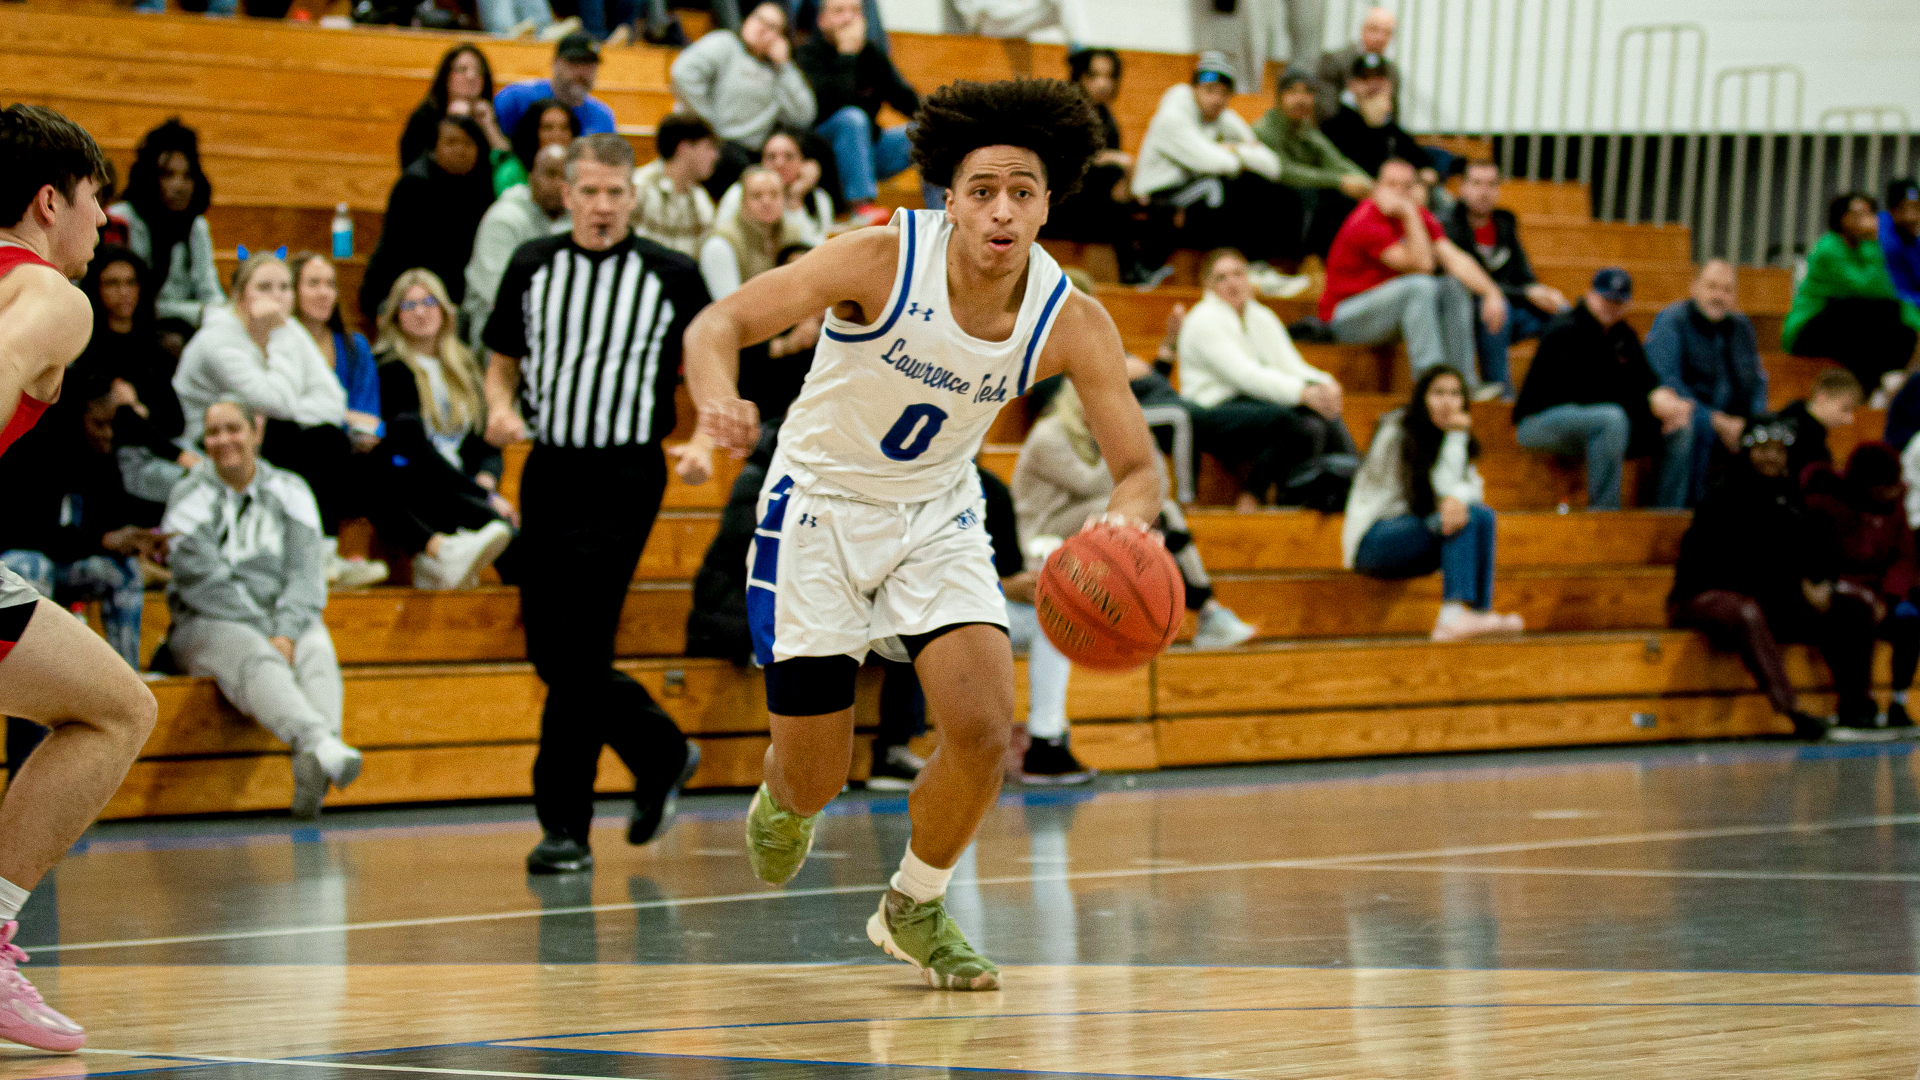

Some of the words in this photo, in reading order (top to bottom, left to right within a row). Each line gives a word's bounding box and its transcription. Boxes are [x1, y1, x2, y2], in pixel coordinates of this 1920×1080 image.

[881, 338, 970, 395] Lawrence
[973, 373, 1007, 404] Tech
[880, 403, 948, 461] 0
